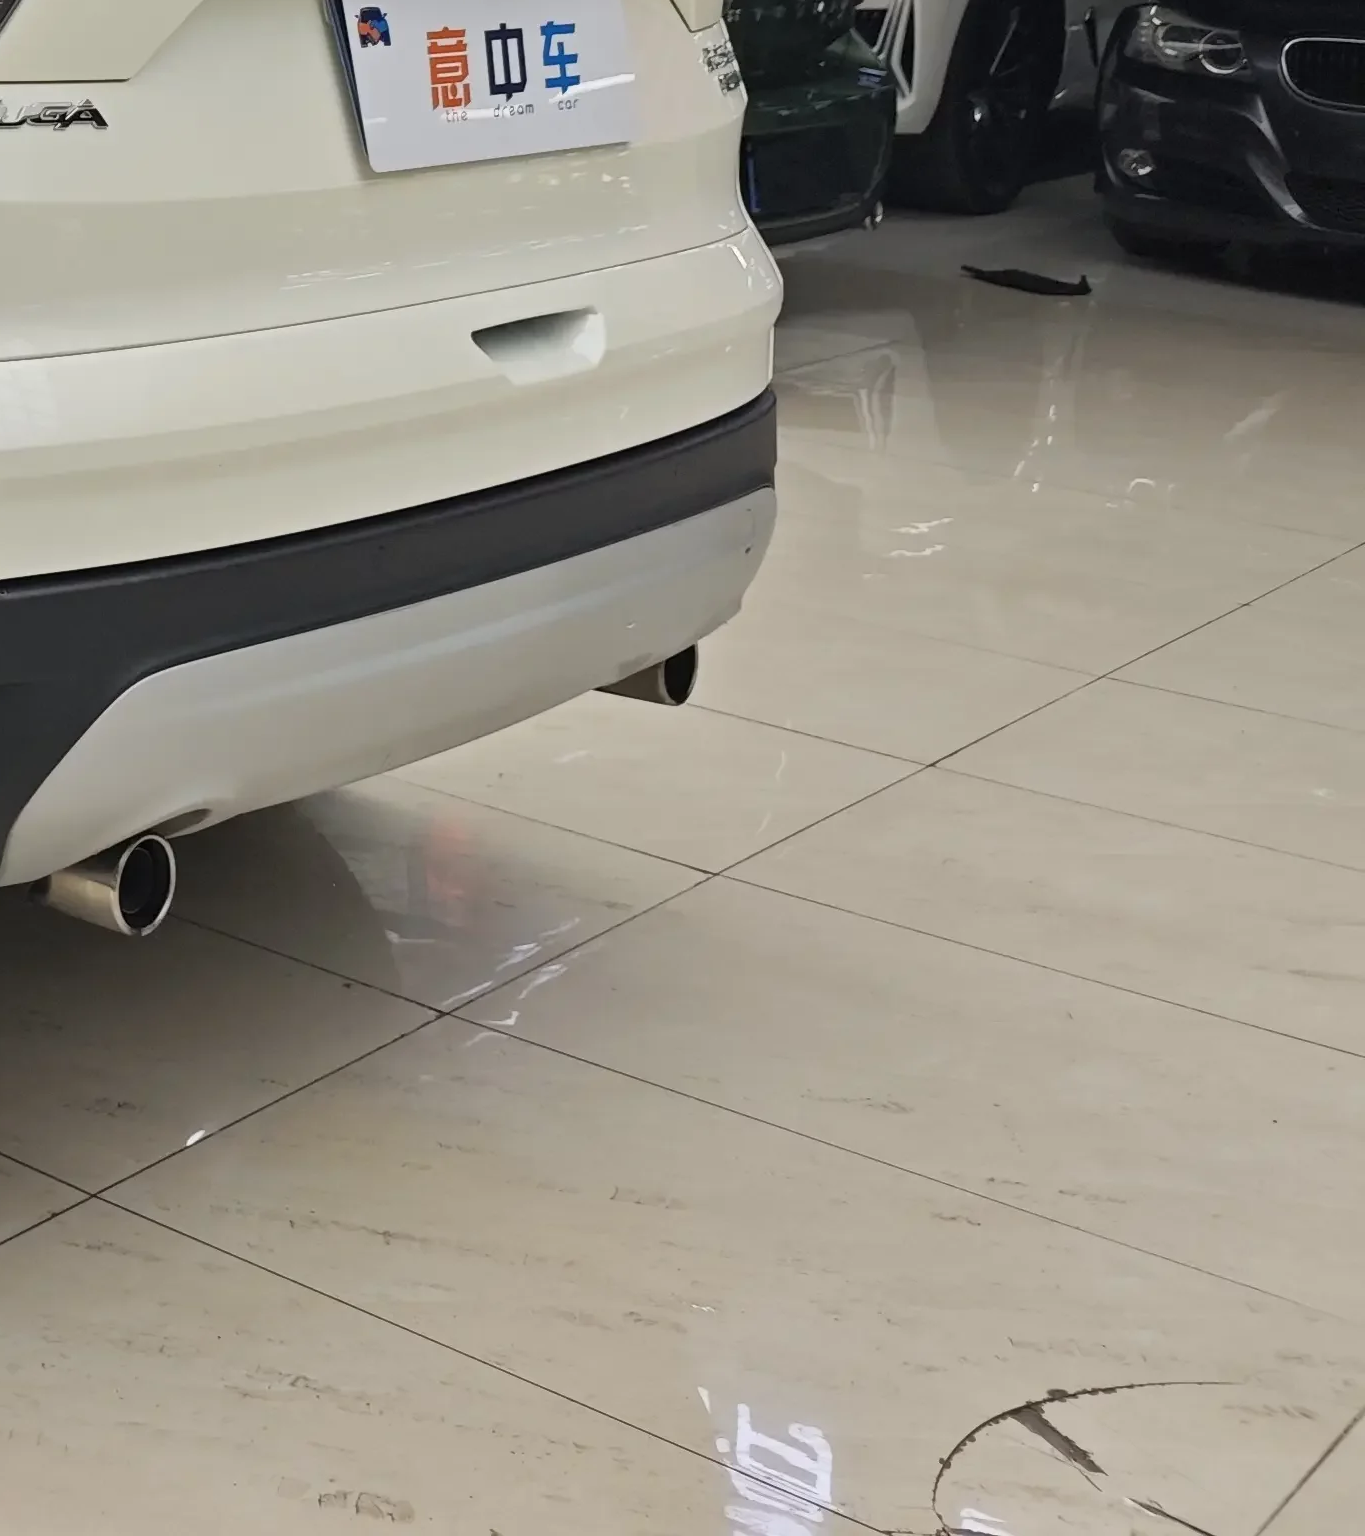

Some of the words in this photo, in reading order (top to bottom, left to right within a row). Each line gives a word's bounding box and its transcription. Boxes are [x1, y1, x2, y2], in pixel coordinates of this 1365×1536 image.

[426, 20, 581, 111] 意中车
[445, 109, 468, 123] the
[493, 103, 535, 118] dream
[557, 96, 580, 111] car
